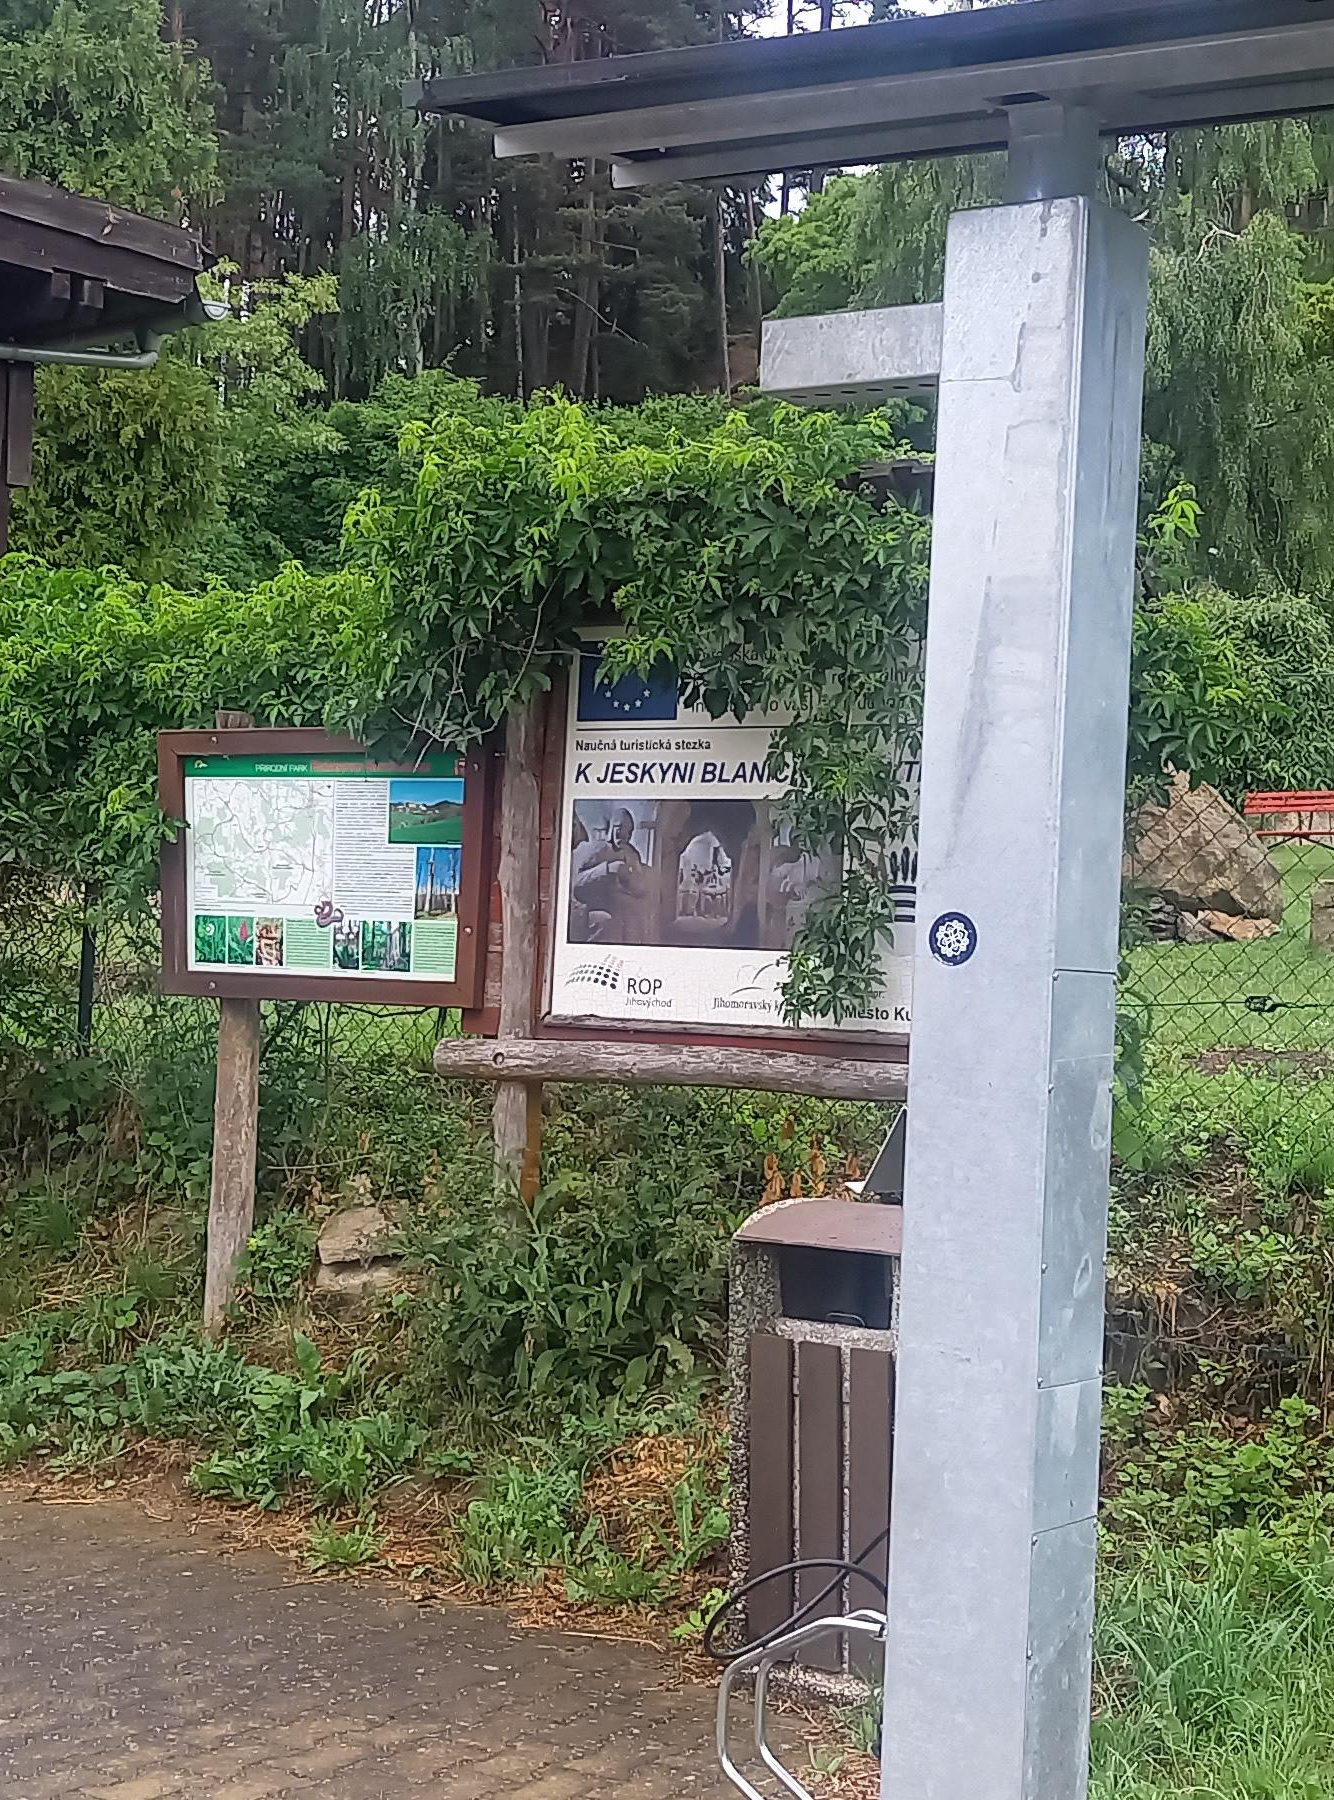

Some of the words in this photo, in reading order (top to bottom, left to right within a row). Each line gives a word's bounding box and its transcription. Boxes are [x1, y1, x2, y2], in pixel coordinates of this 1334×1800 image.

[575, 739, 616, 751] Naučná
[620, 739, 672, 751] turistická
[674, 738, 711, 750] stezka
[575, 762, 593, 784] K
[596, 762, 696, 784] JESKYNI
[627, 977, 662, 995] ROP
[625, 997, 672, 1009] Jihovýchod
[713, 997, 772, 1013] Jihomoravský
